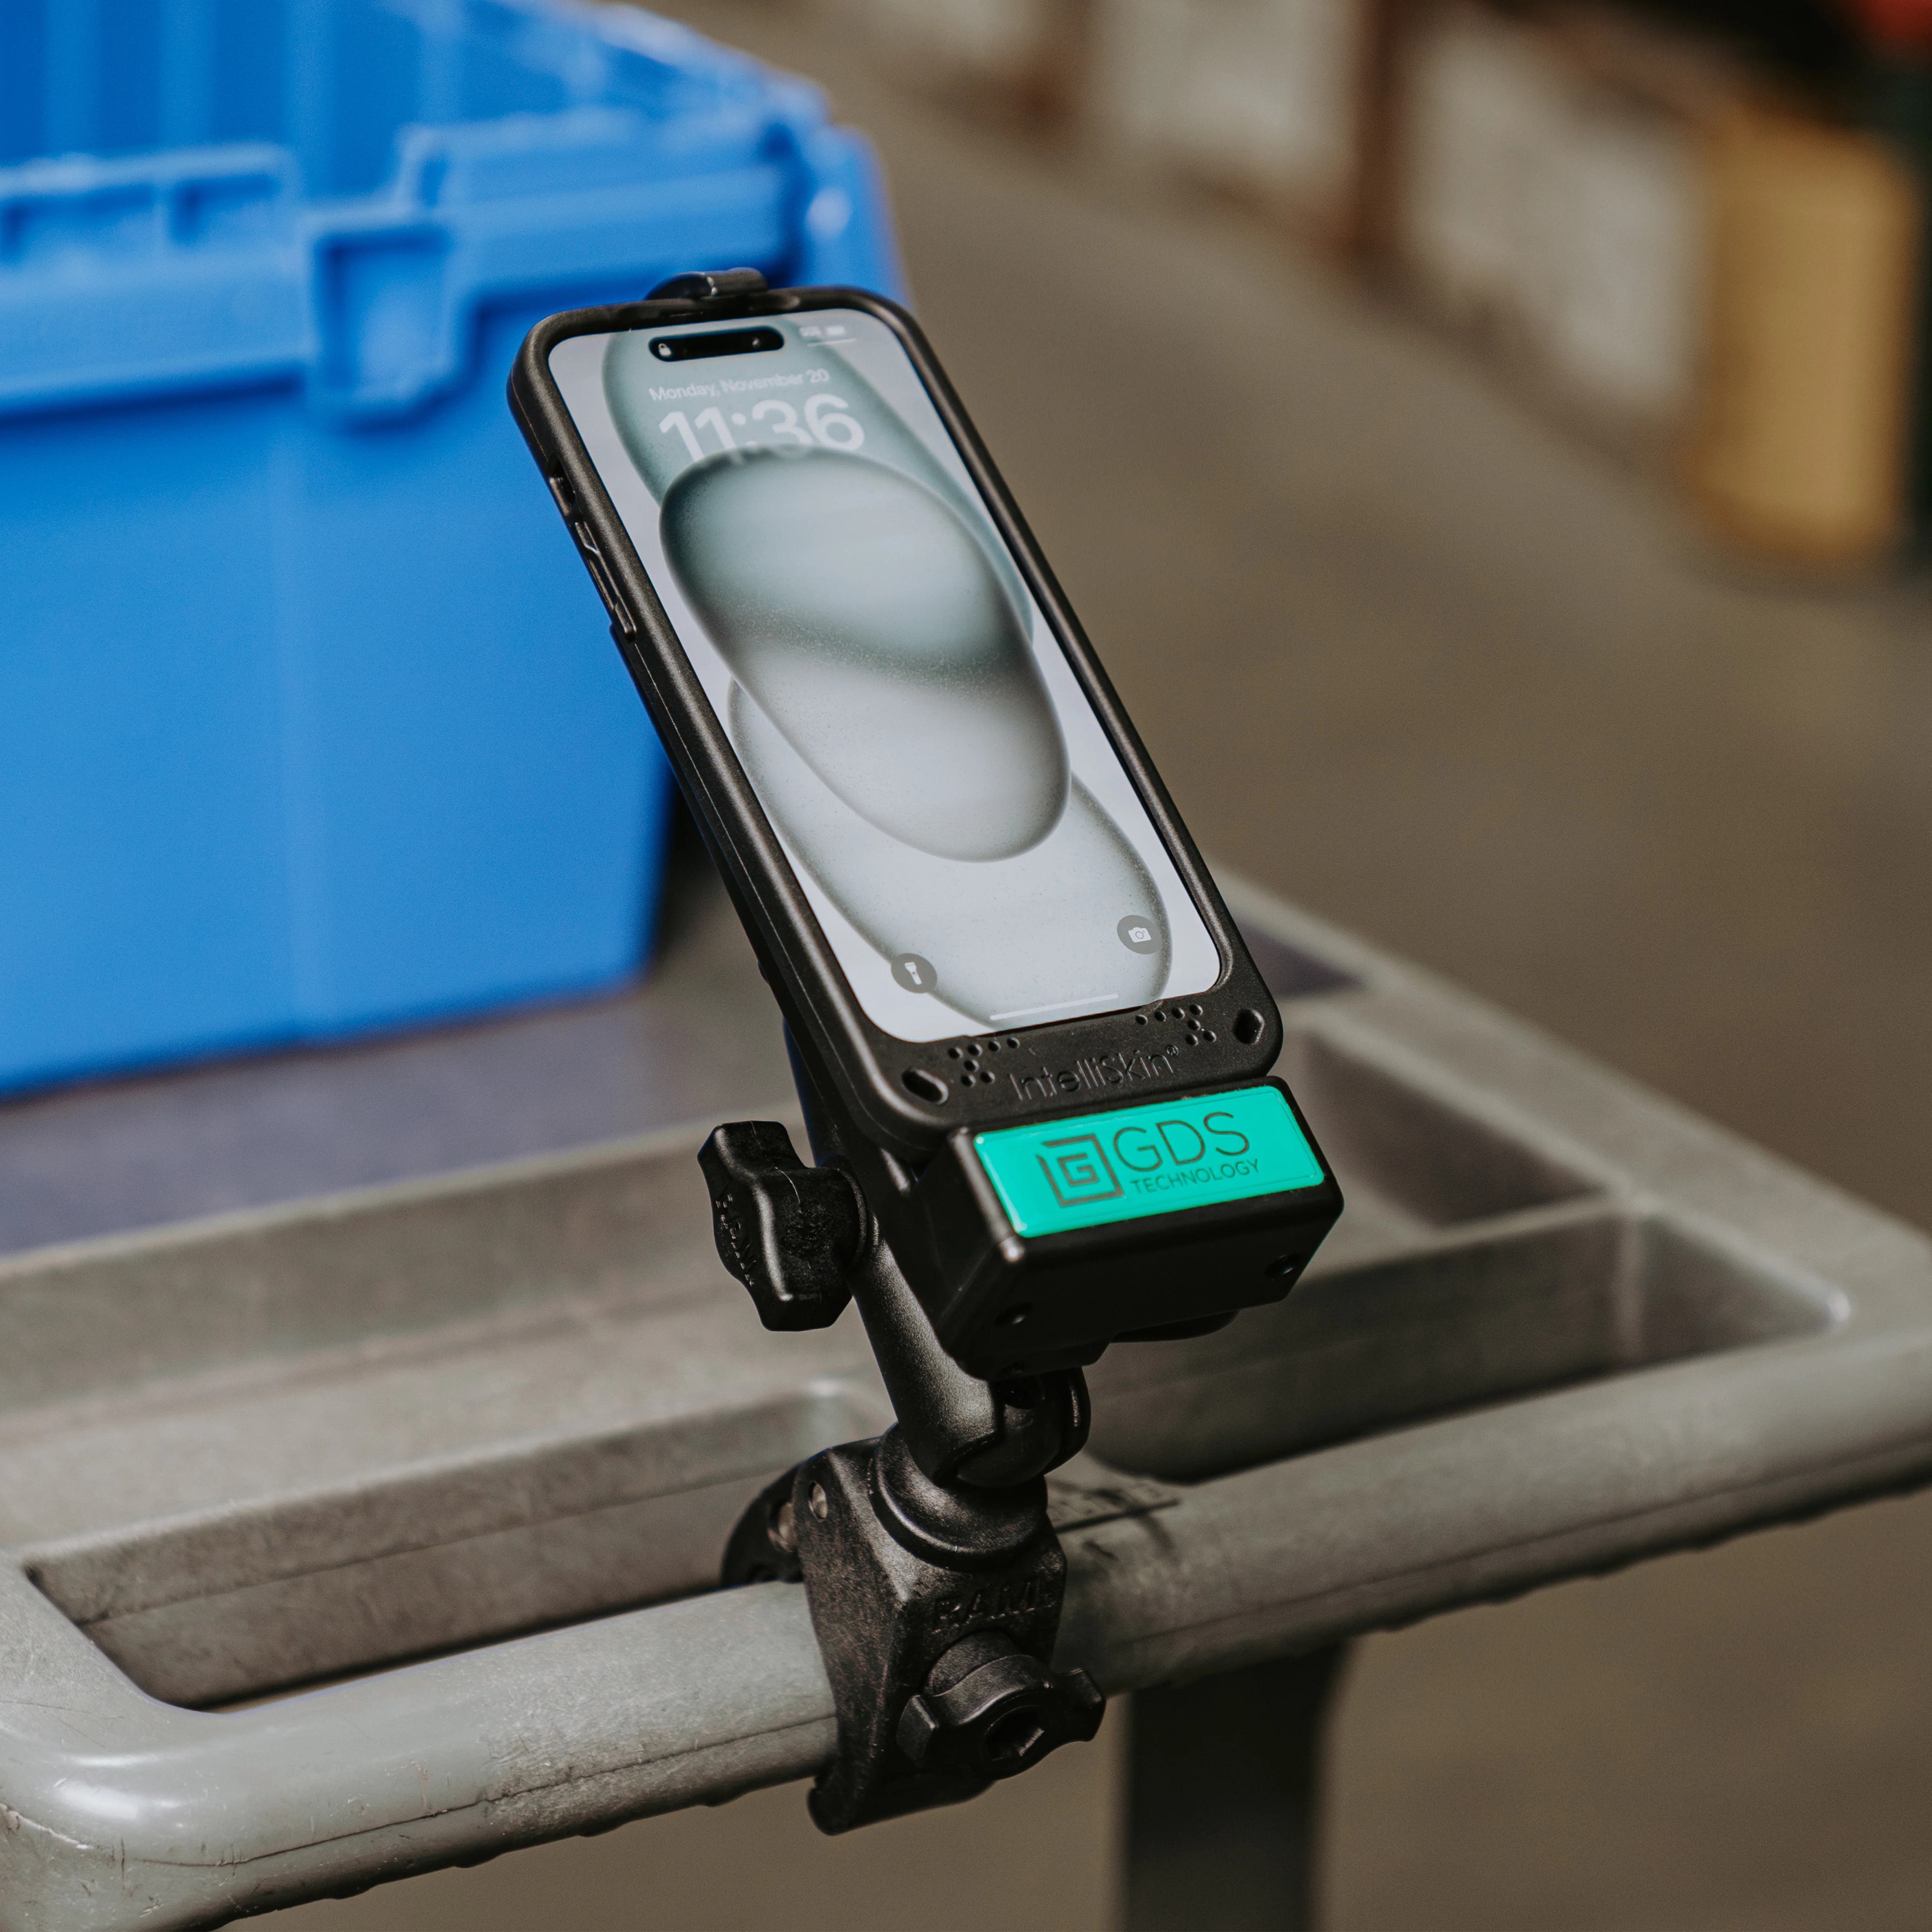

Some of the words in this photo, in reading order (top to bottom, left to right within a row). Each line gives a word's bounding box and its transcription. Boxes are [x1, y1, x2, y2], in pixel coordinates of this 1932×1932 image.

[649, 383, 721, 401] Monday,
[720, 373, 804, 393] November
[805, 368, 830, 384] 20
[659, 393, 865, 462] 11:36
[1113, 1112, 1250, 1172] GDS
[1131, 1158, 1259, 1194] TECHNOLOGY
